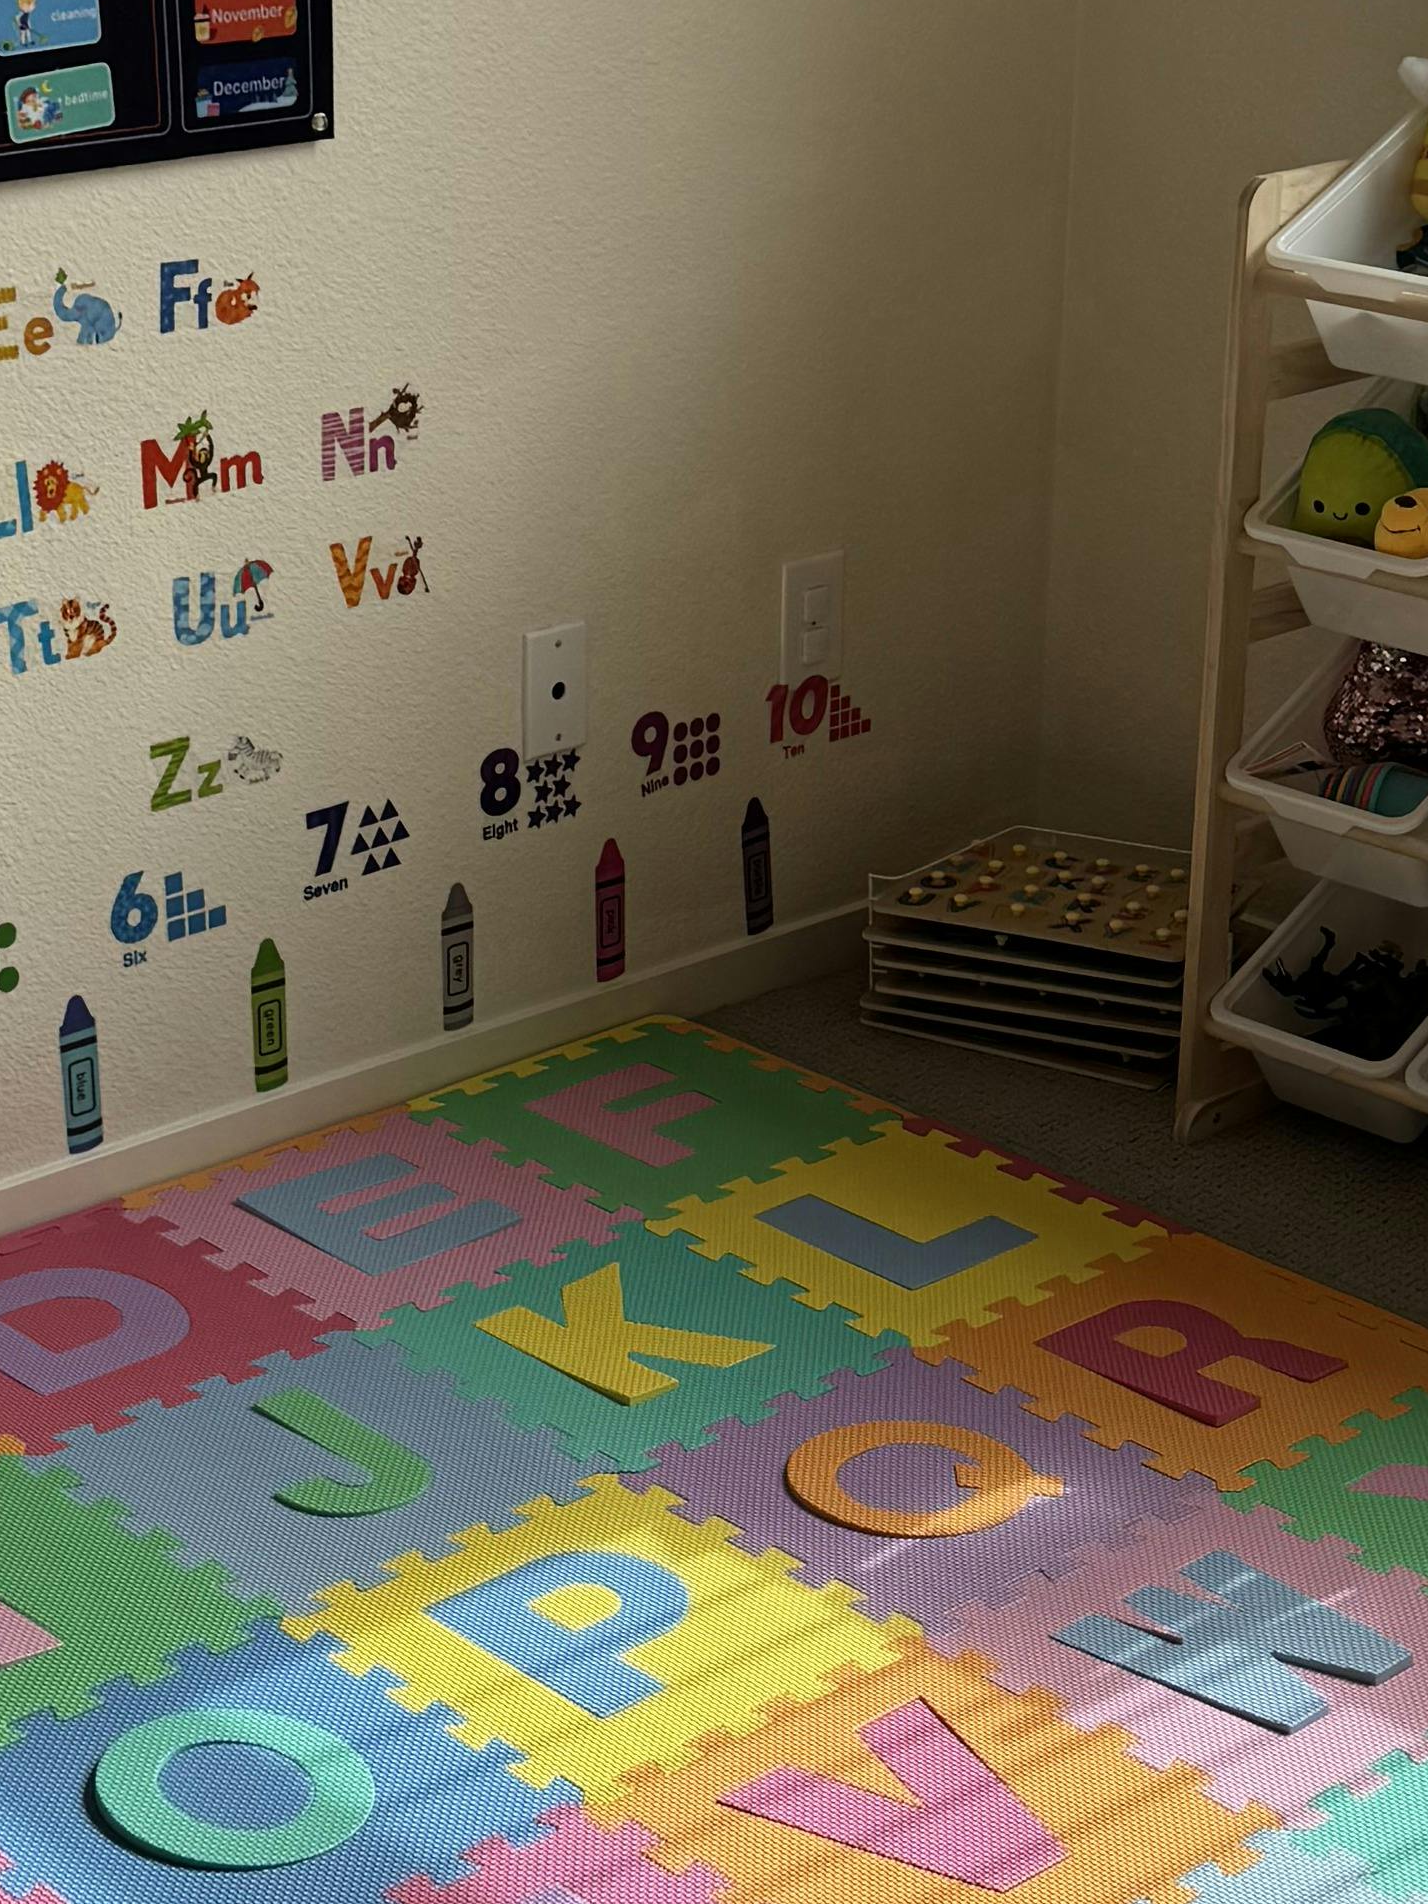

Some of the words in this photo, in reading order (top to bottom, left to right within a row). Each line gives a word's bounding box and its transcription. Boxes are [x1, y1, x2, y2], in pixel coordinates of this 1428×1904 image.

[50, 6, 97, 22] cleaning
[211, 4, 283, 25] November
[65, 88, 108, 107] bedtime
[213, 75, 285, 96] December
[158, 259, 211, 334] Ff
[782, 742, 806, 760] Ten
[640, 772, 669, 798] Nine
[483, 818, 519, 841] Eight
[303, 875, 349, 902] Seven
[123, 949, 148, 968] Six
[452, 953, 464, 983] grey
[264, 1008, 276, 1046] green
[233, 1154, 522, 1277] E
[473, 1260, 776, 1406] K
[1034, 1297, 1349, 1428] R
[423, 1549, 690, 1719] P
